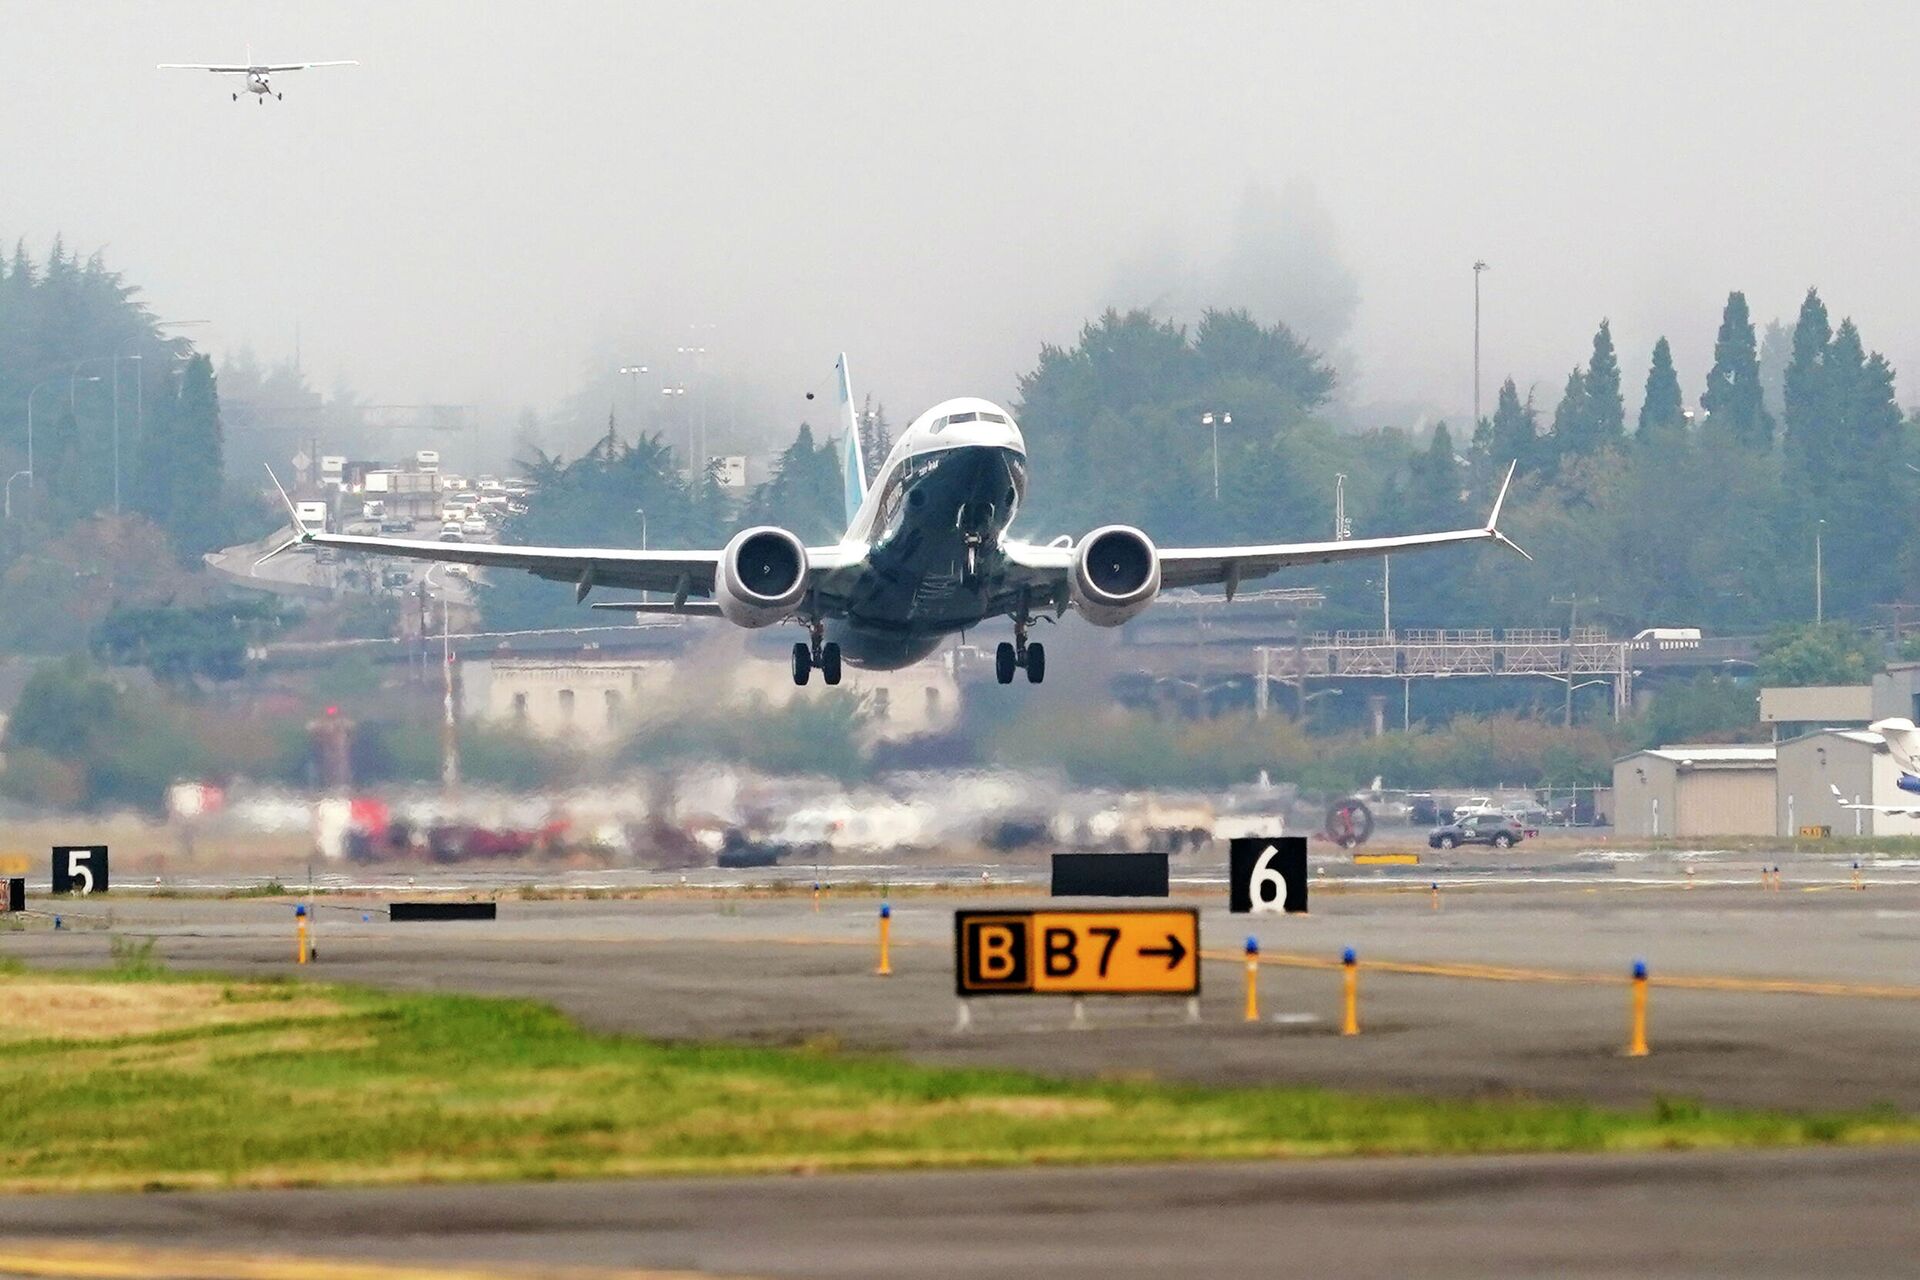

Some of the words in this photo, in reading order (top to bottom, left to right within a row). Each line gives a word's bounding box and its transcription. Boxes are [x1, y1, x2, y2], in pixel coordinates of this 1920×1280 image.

[68, 850, 93, 896] 5
[1249, 844, 1287, 912] 6
[979, 925, 1016, 980] B
[1044, 926, 1122, 978] B7
